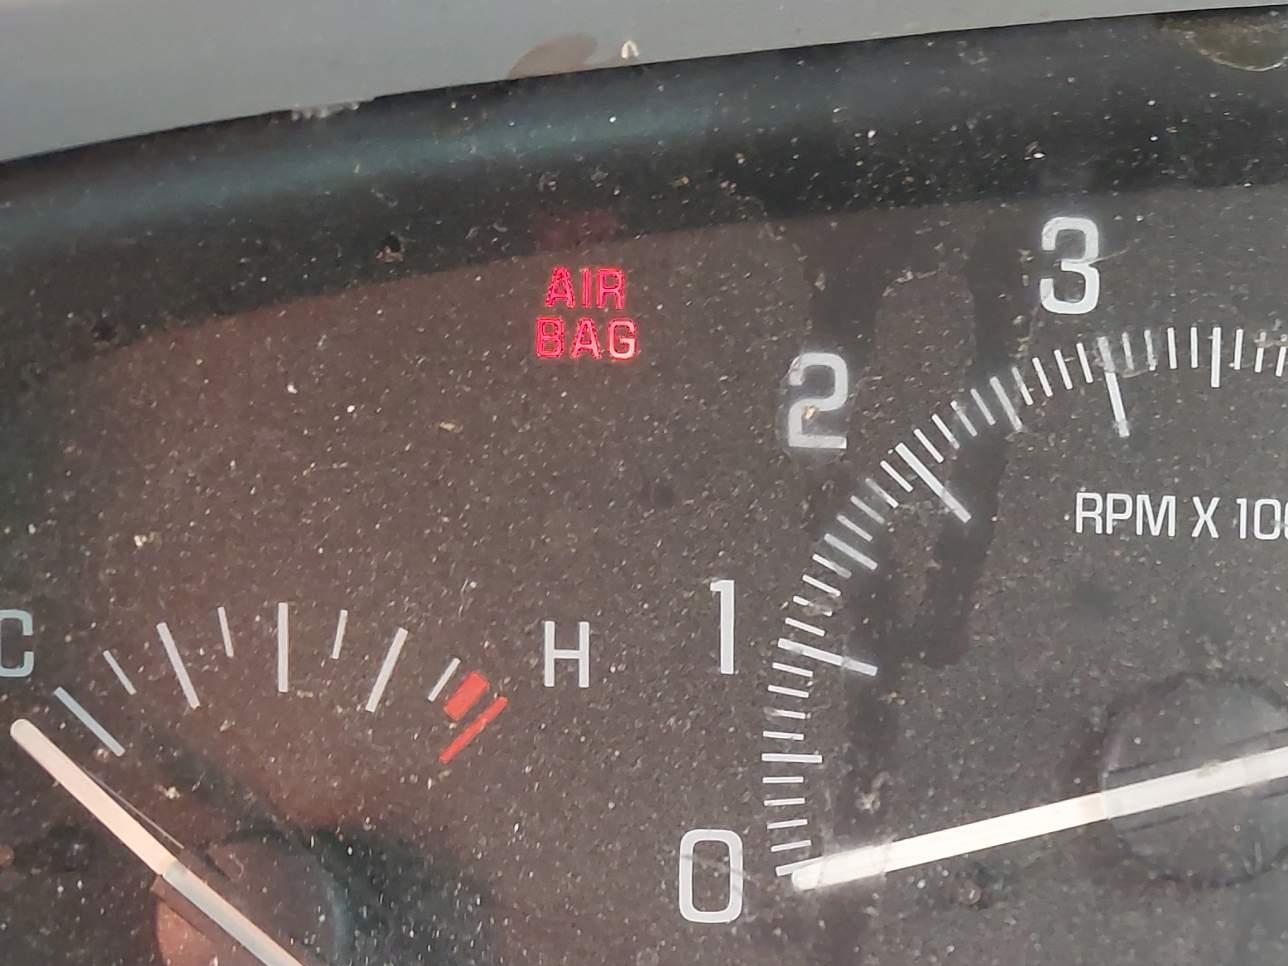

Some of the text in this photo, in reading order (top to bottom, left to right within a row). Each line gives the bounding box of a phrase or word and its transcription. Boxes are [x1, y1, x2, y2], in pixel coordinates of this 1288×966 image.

[544, 266, 627, 310] AIR
[1039, 217, 1100, 315] 3
[535, 316, 639, 361] BAG
[786, 352, 850, 449] 2
[1074, 492, 1178, 537] RPM
[1189, 497, 1221, 539] X
[0, 609, 35, 678] C
[543, 620, 591, 688] H
[709, 578, 736, 675] 1
[678, 828, 744, 924] 0
